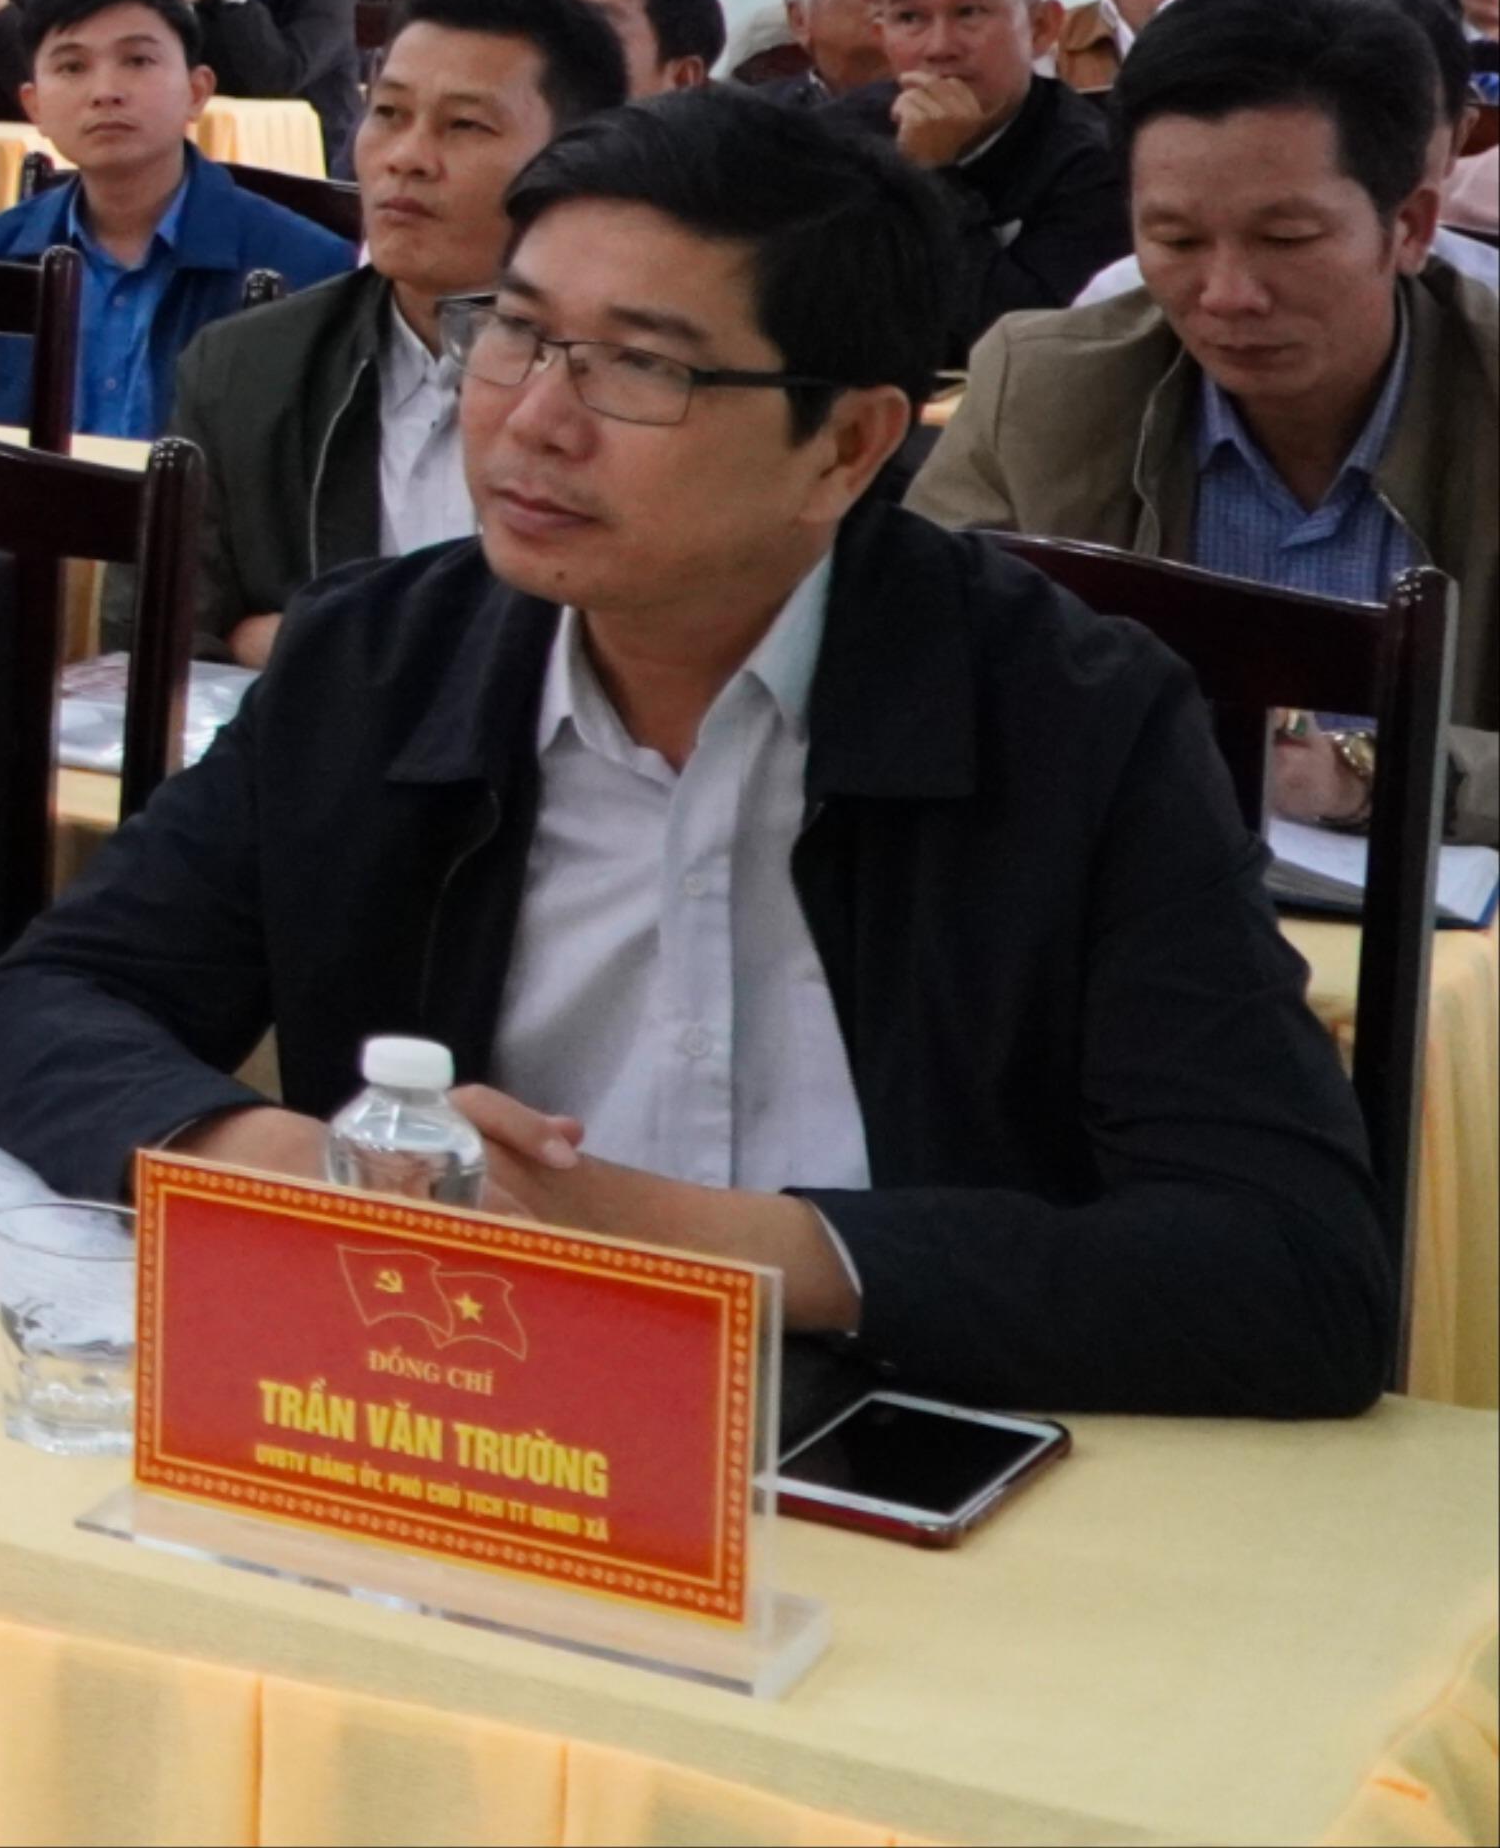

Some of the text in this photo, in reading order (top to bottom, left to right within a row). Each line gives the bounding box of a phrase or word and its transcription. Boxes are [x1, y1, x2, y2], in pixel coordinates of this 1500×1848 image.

[367, 1346, 495, 1397] ĐỒNG CHÍ
[258, 1377, 610, 1499] TRẦN VĂN TRƯỜNG
